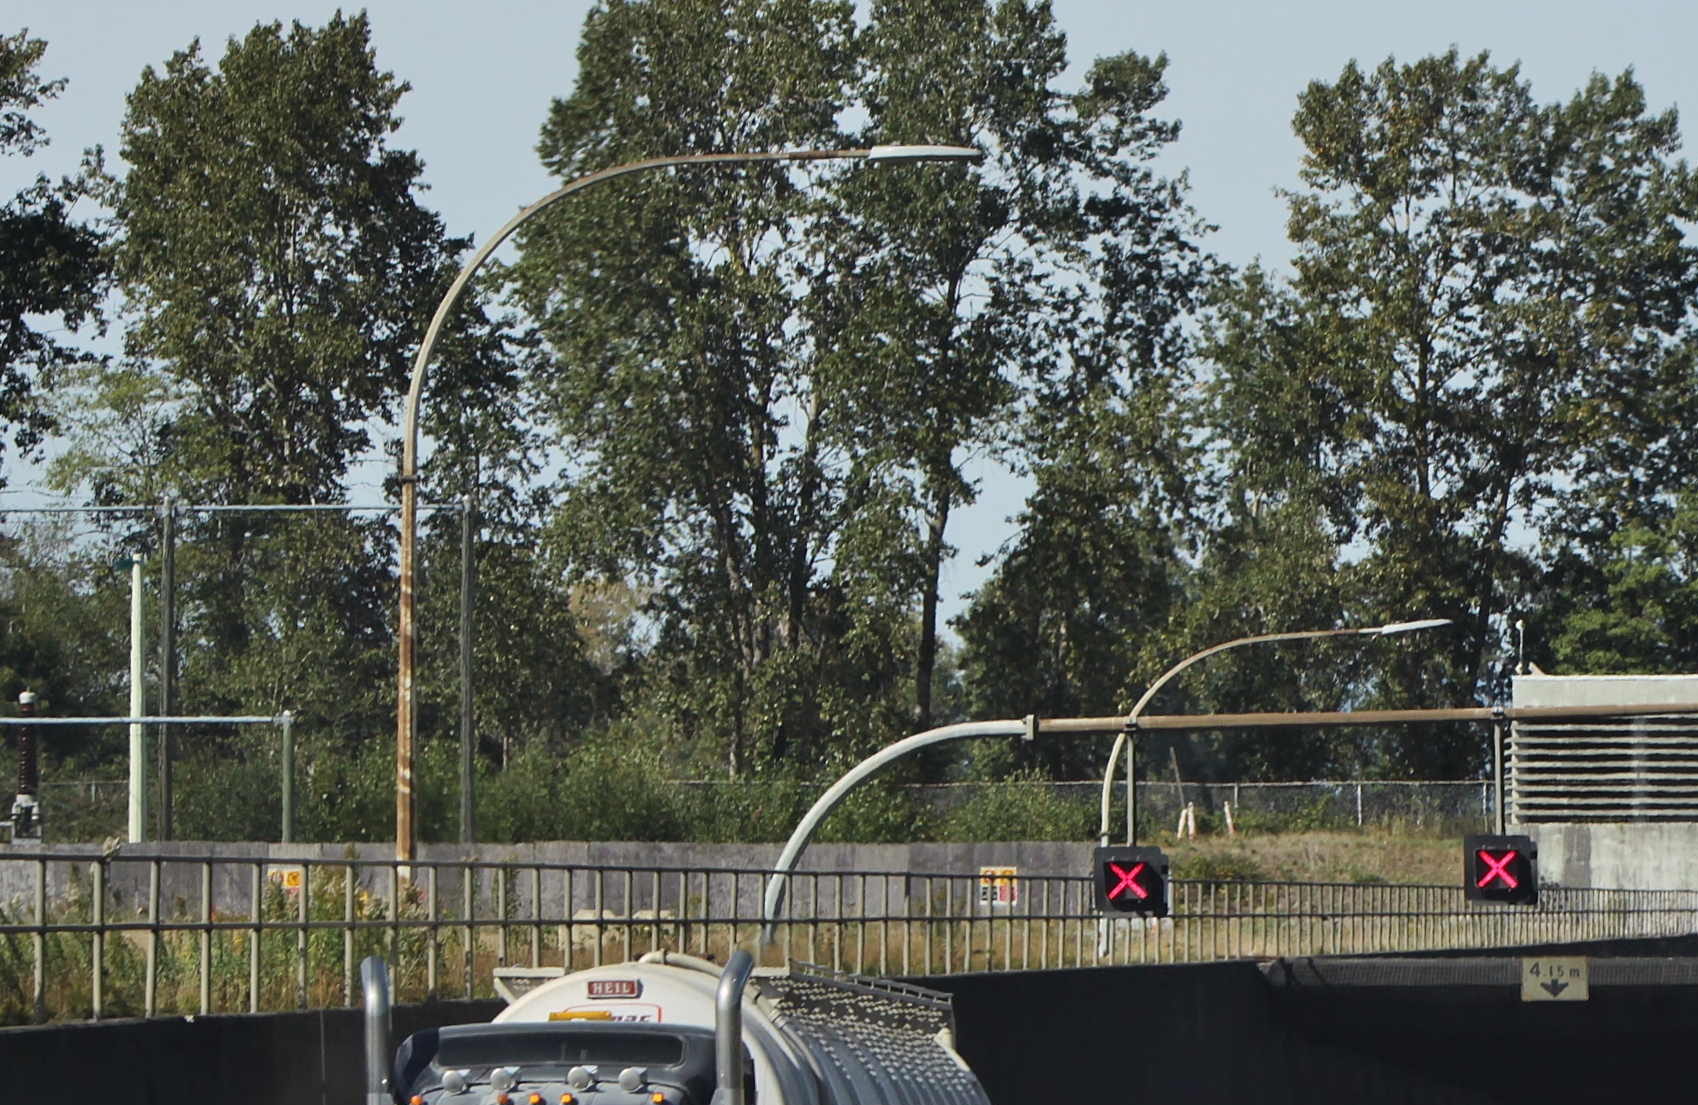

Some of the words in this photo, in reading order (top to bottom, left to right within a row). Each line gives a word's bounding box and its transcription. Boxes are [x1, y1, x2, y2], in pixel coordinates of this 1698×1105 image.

[1529, 961, 1565, 978] 4.15
[1569, 968, 1580, 978] m
[592, 982, 631, 994] HEIL
